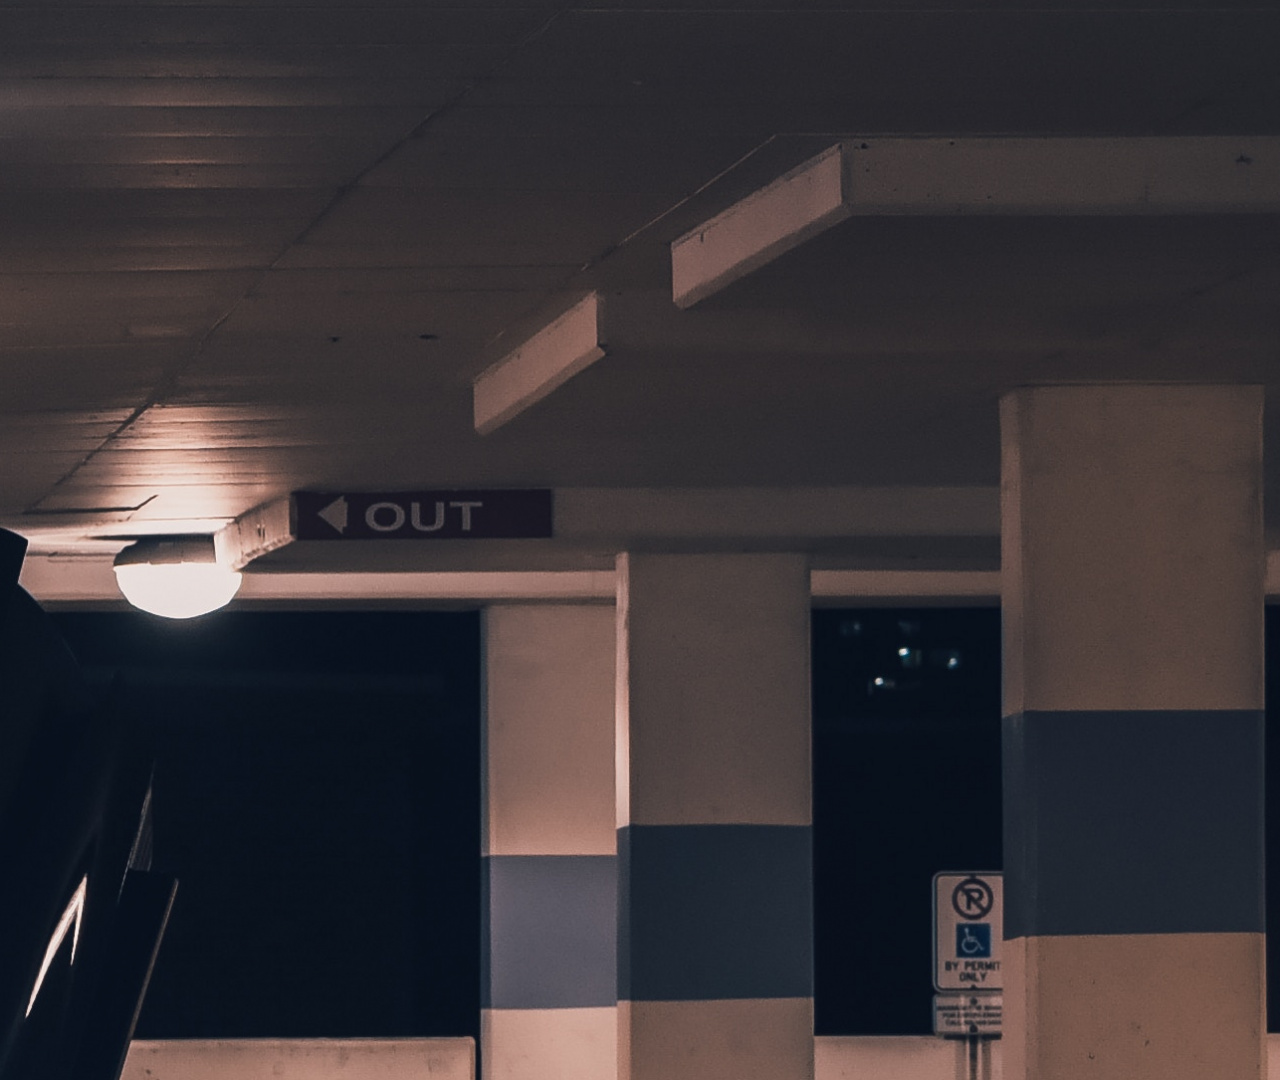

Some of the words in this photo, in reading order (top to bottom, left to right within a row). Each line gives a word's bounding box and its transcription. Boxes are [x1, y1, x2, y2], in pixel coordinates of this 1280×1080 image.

[365, 501, 483, 531] OUT
[944, 961, 959, 971] BY
[964, 960, 1000, 971] PERMIT
[959, 972, 987, 982] ONLY
